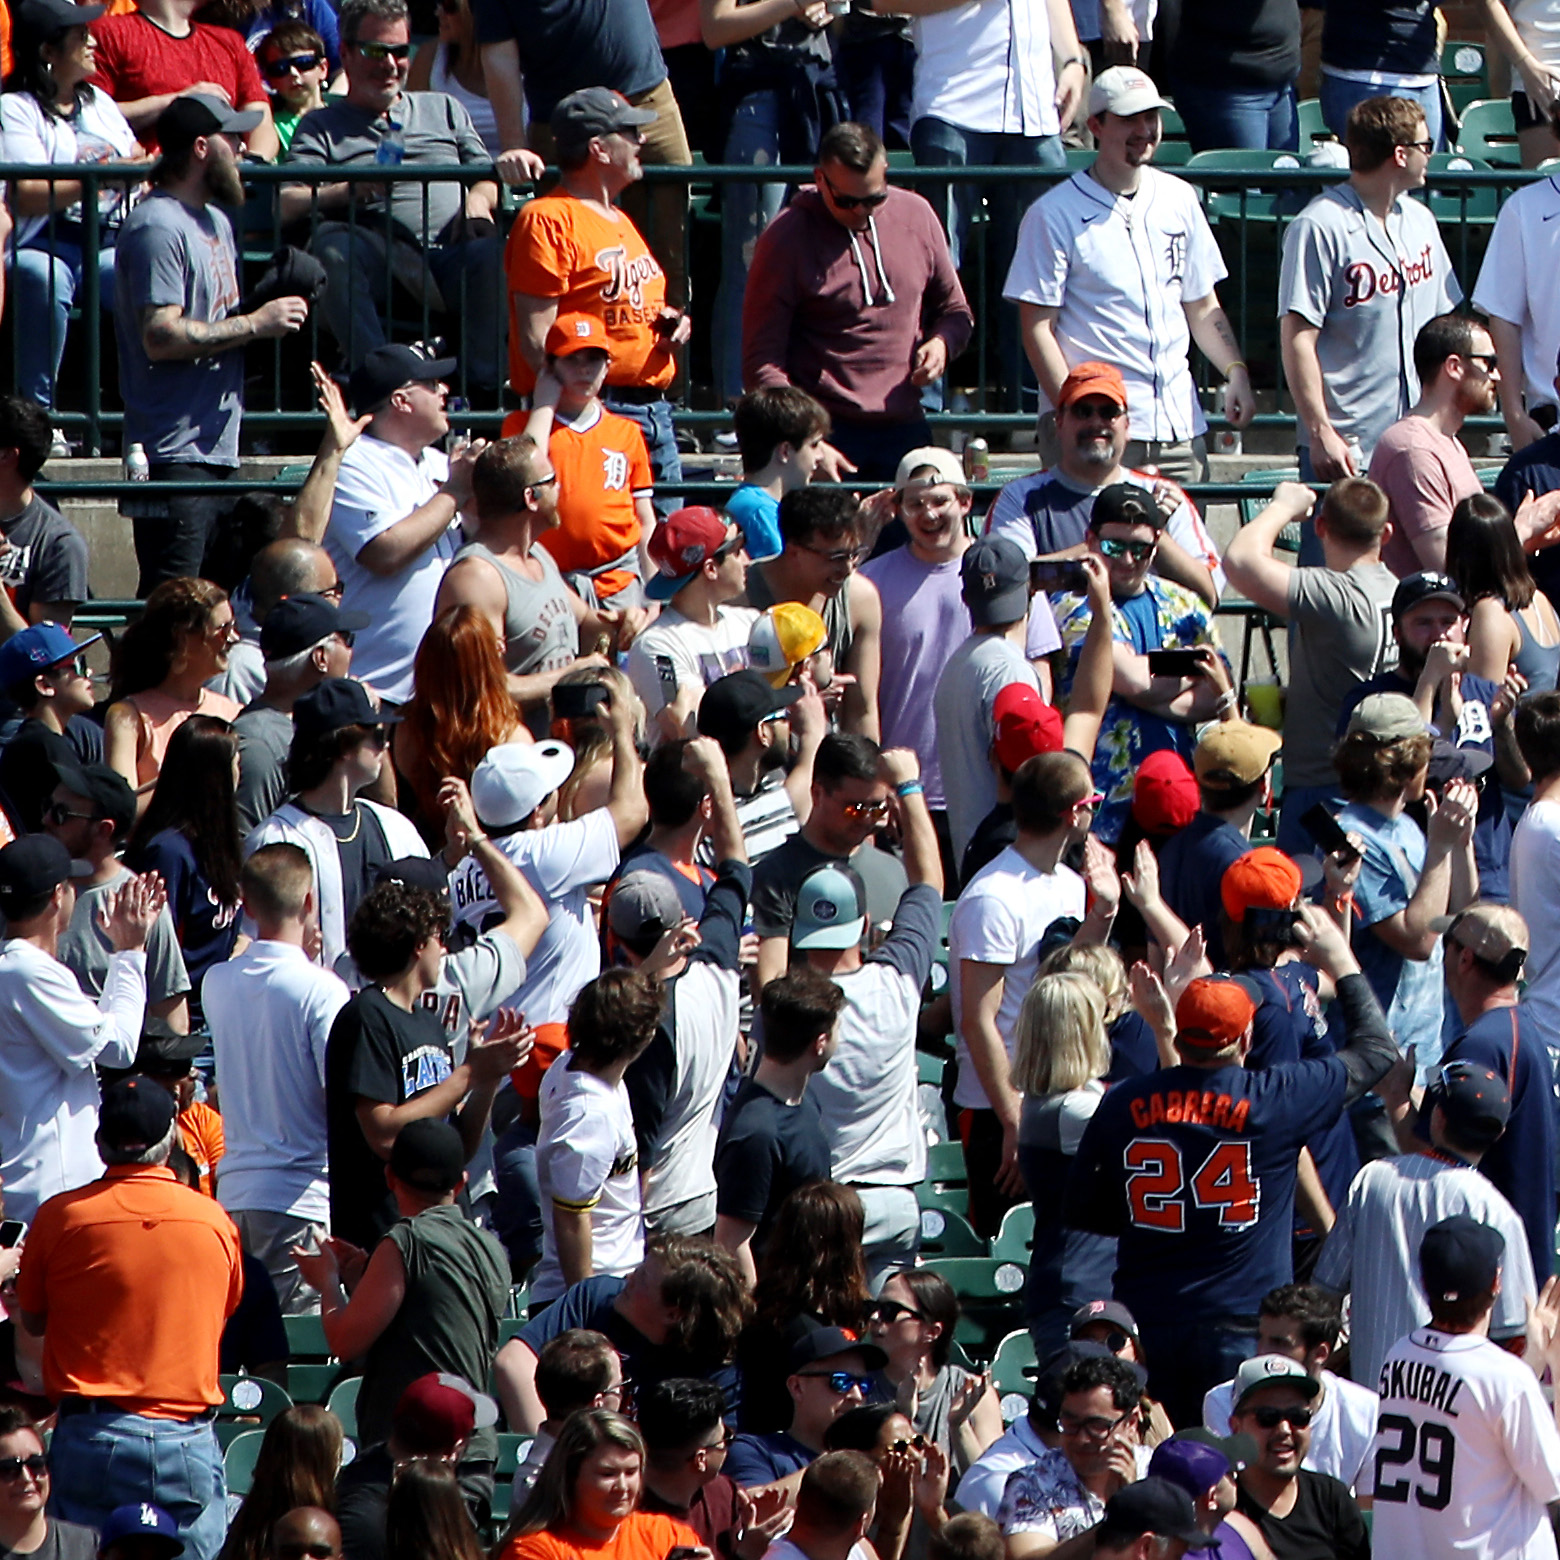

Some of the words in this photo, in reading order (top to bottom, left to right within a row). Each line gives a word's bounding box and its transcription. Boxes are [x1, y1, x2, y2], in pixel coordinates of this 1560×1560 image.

[1343, 243, 1434, 309] Detroit
[531, 598, 576, 643] DETRO
[1130, 1090, 1251, 1133] CABRERA
[1123, 1137, 1261, 1233] 24
[1378, 1359, 1465, 1418] SKUBAL
[1374, 1412, 1456, 1511] 29
